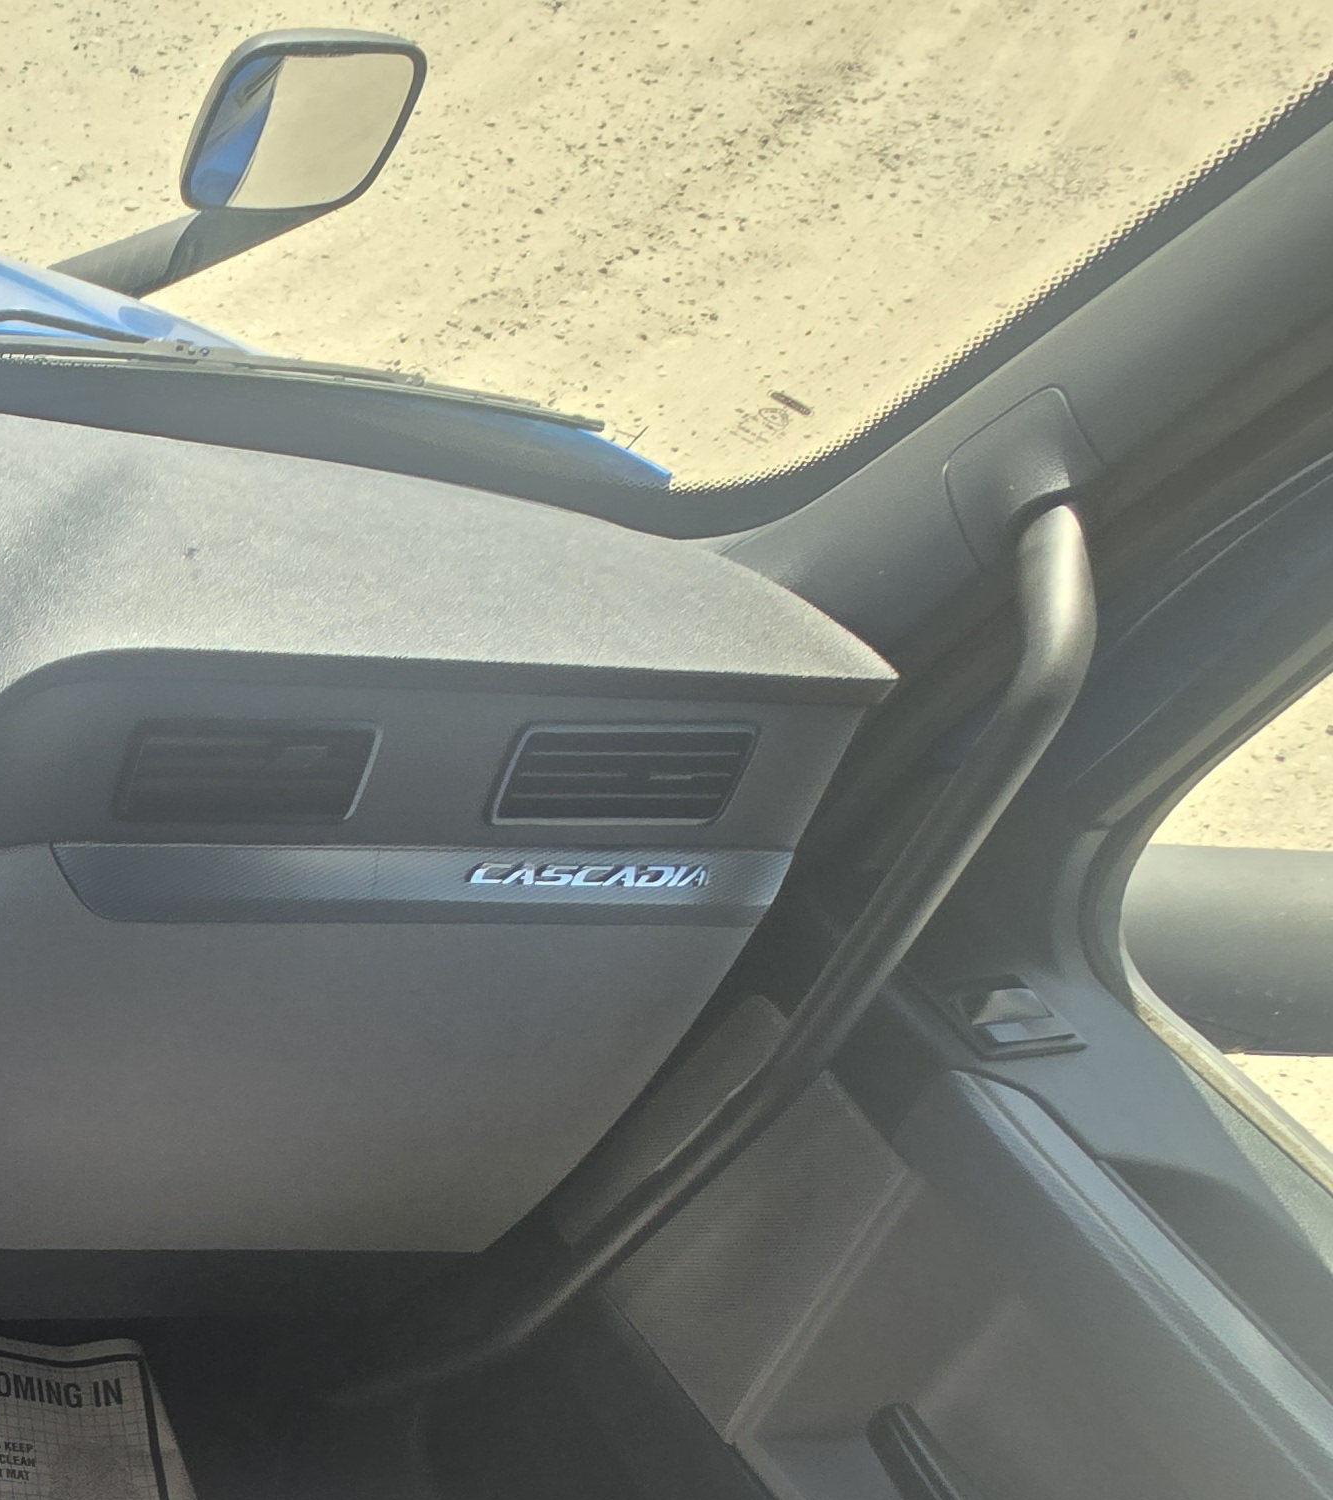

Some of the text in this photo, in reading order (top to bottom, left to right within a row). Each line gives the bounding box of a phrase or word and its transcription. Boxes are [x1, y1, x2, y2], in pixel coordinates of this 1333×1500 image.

[469, 862, 707, 888] CASCADIA
[93, 1378, 124, 1408] IN
[4, 1441, 34, 1453] KEEP
[6, 1468, 31, 1481] MAT
